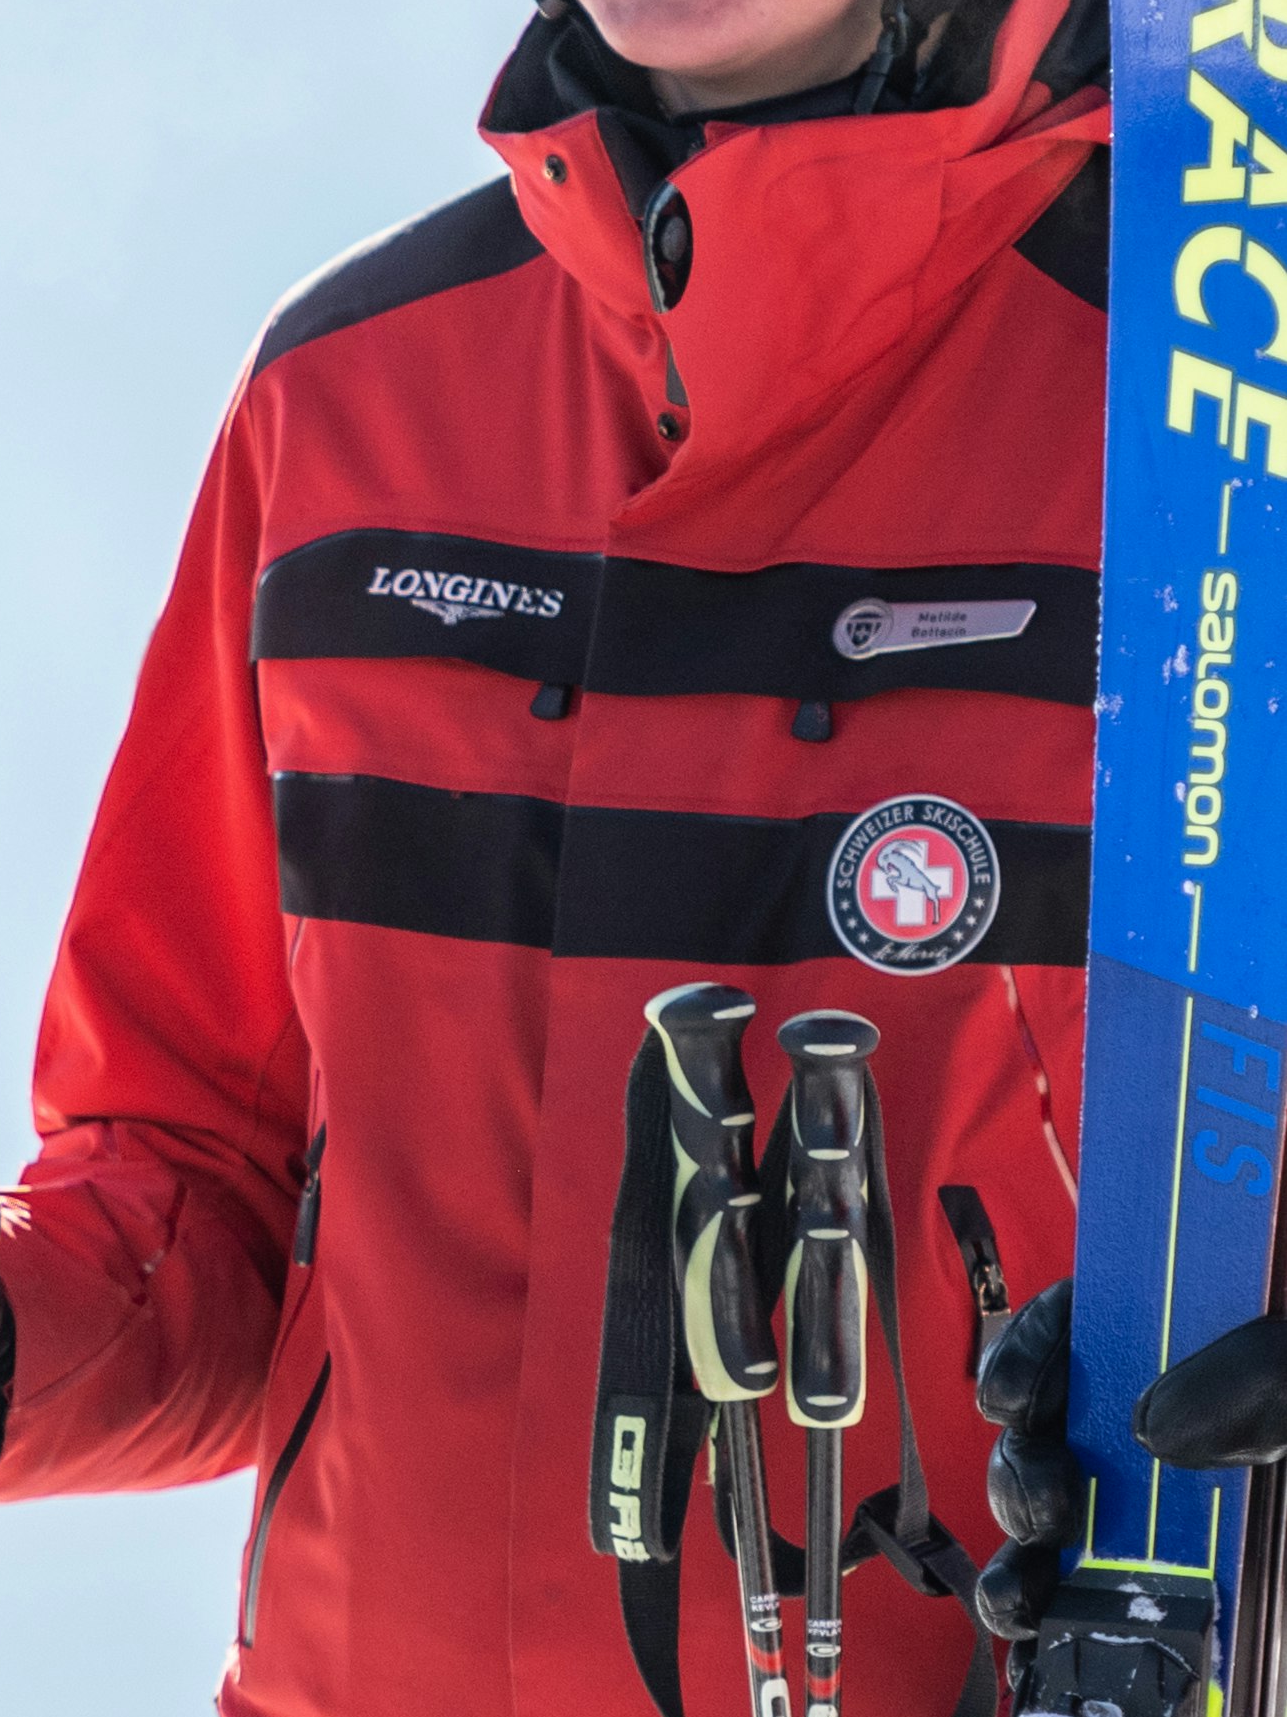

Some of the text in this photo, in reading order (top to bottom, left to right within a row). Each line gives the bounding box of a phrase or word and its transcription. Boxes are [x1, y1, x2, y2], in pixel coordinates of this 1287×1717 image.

[368, 566, 564, 618] LONGINES
[1183, 570, 1237, 868] salomon
[837, 804, 991, 890] SCHWEIZER SKISCHULE
[1190, 1017, 1283, 1202] FIS
